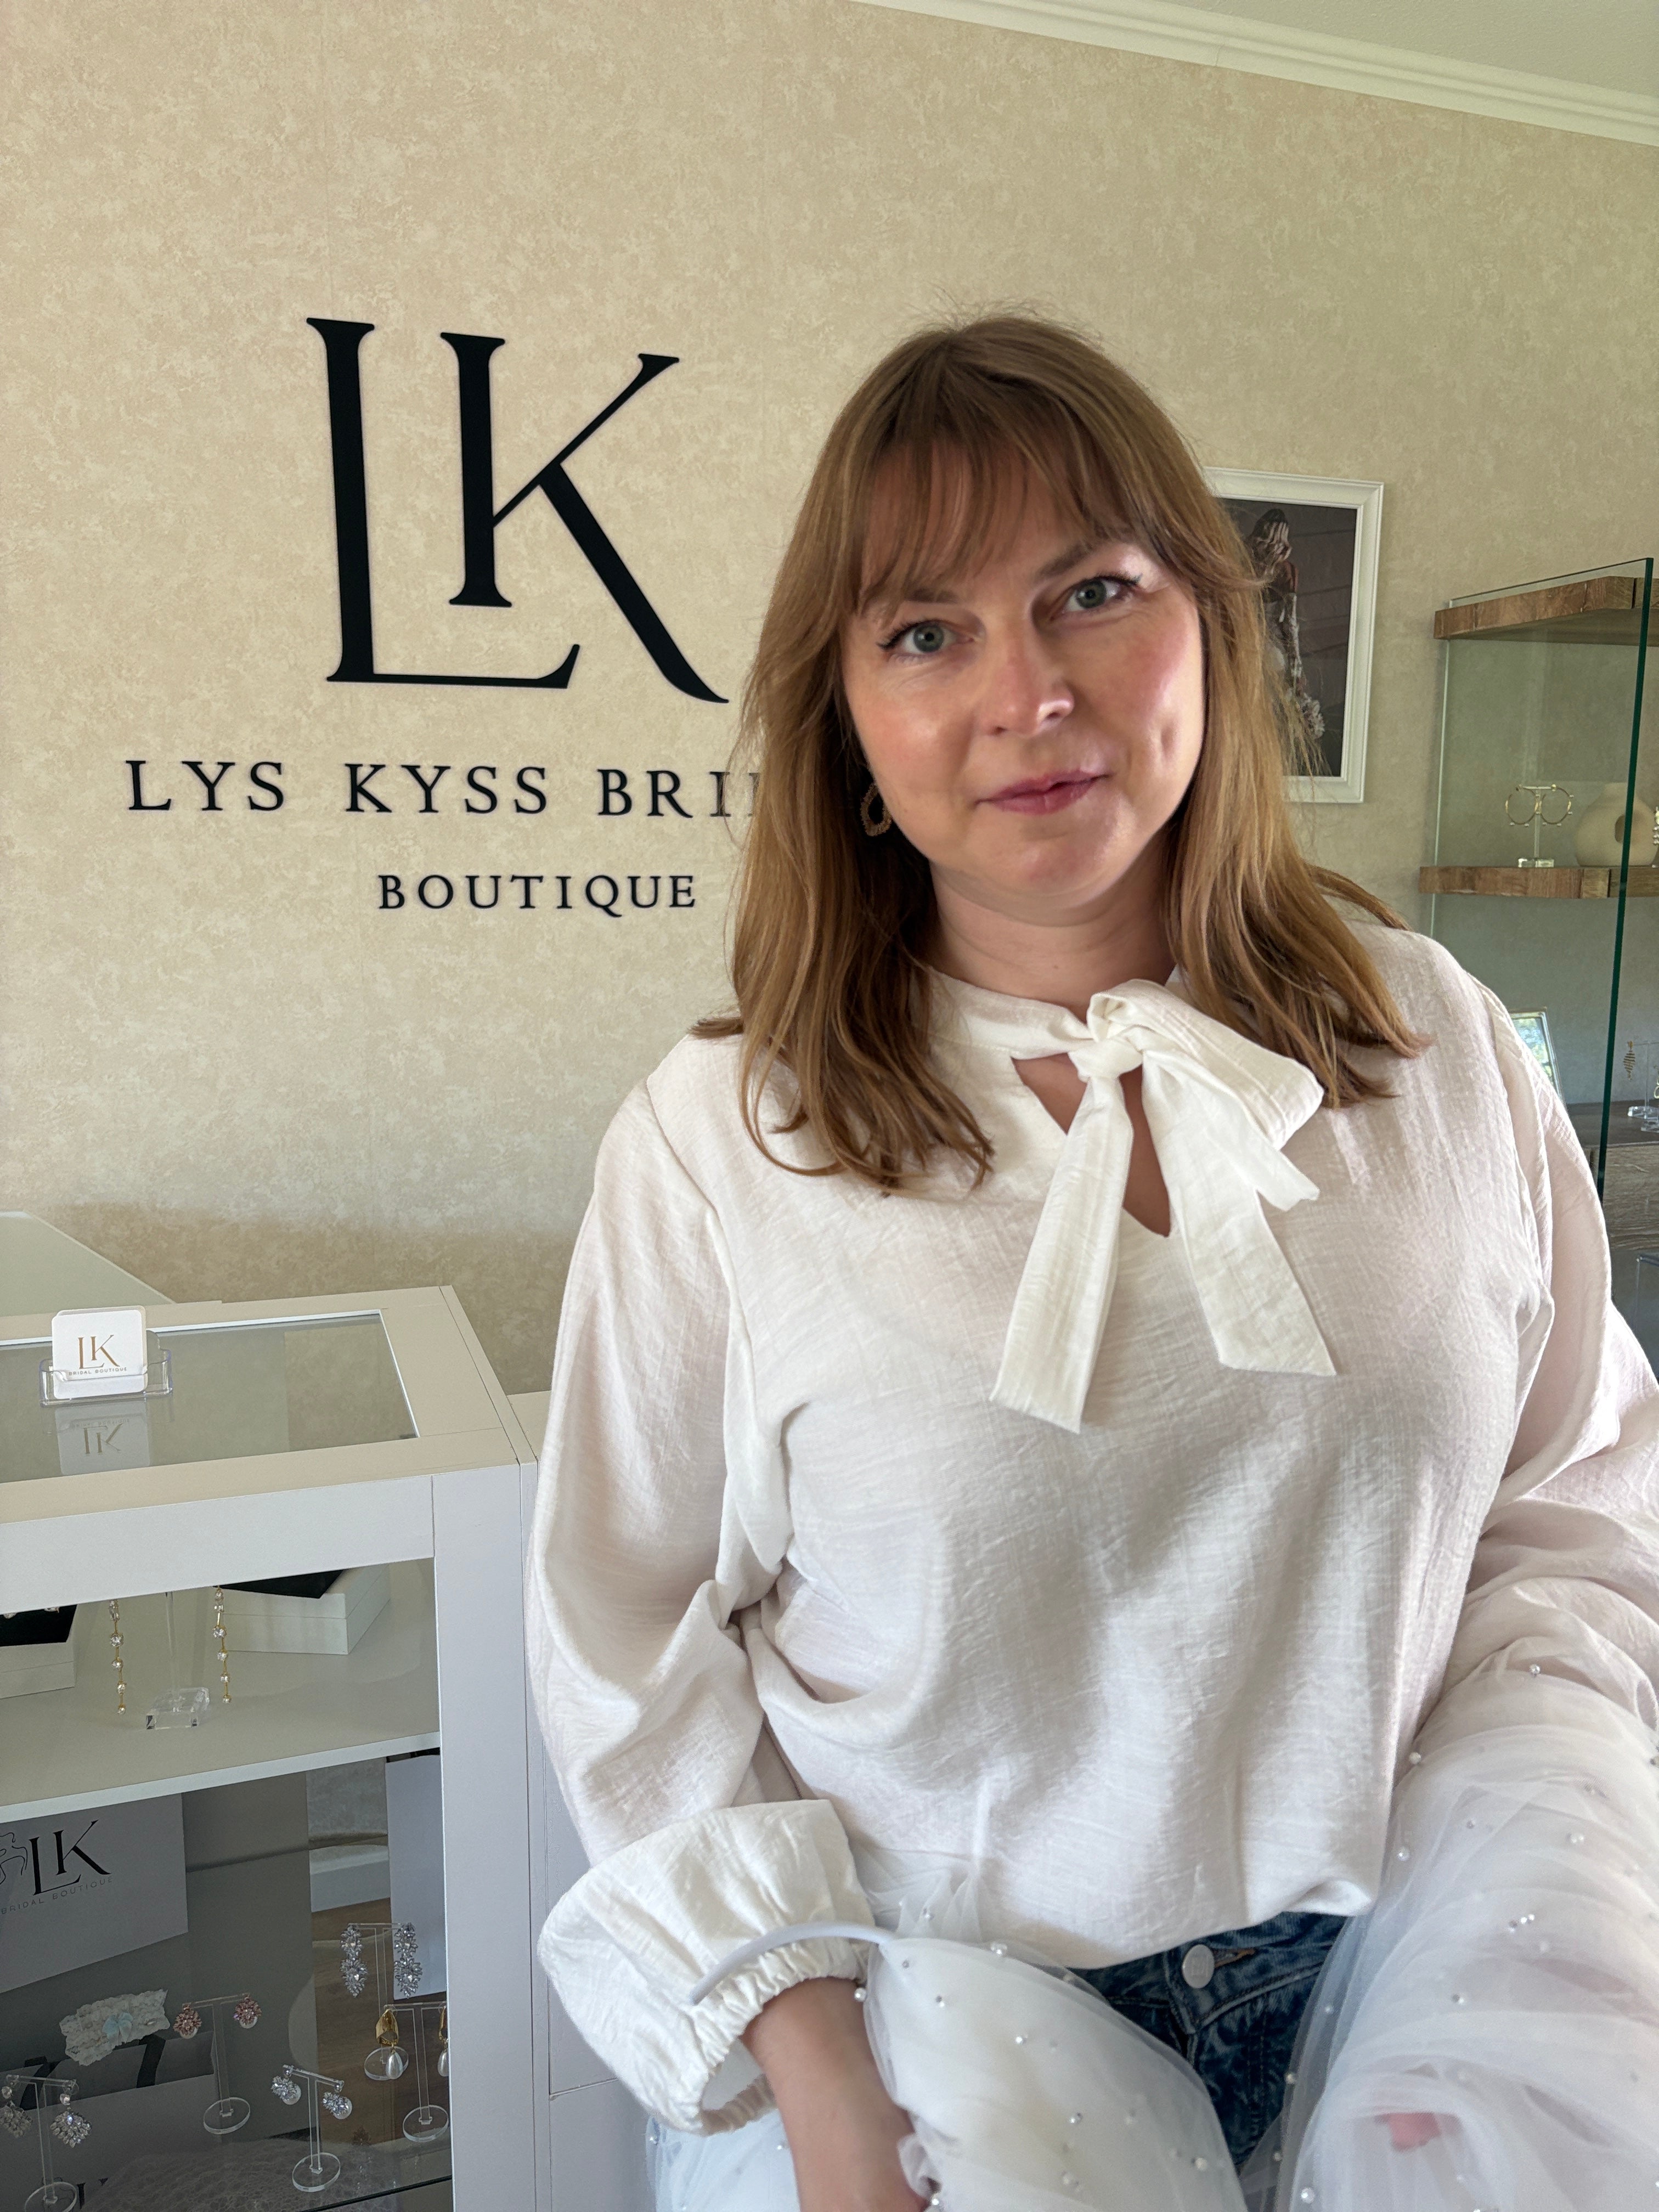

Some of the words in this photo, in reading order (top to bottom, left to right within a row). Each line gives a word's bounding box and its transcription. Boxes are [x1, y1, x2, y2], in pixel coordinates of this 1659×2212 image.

[306, 317, 729, 704] LK
[125, 760, 284, 811] LYS
[345, 763, 546, 814] KYSS
[378, 874, 695, 918] BOUTIQUE
[77, 1334, 120, 1369] LK
[29, 1820, 111, 1896] LK
[1, 1898, 44, 1915] BRIDAL
[52, 1876, 112, 1900] BOUTIQUE
